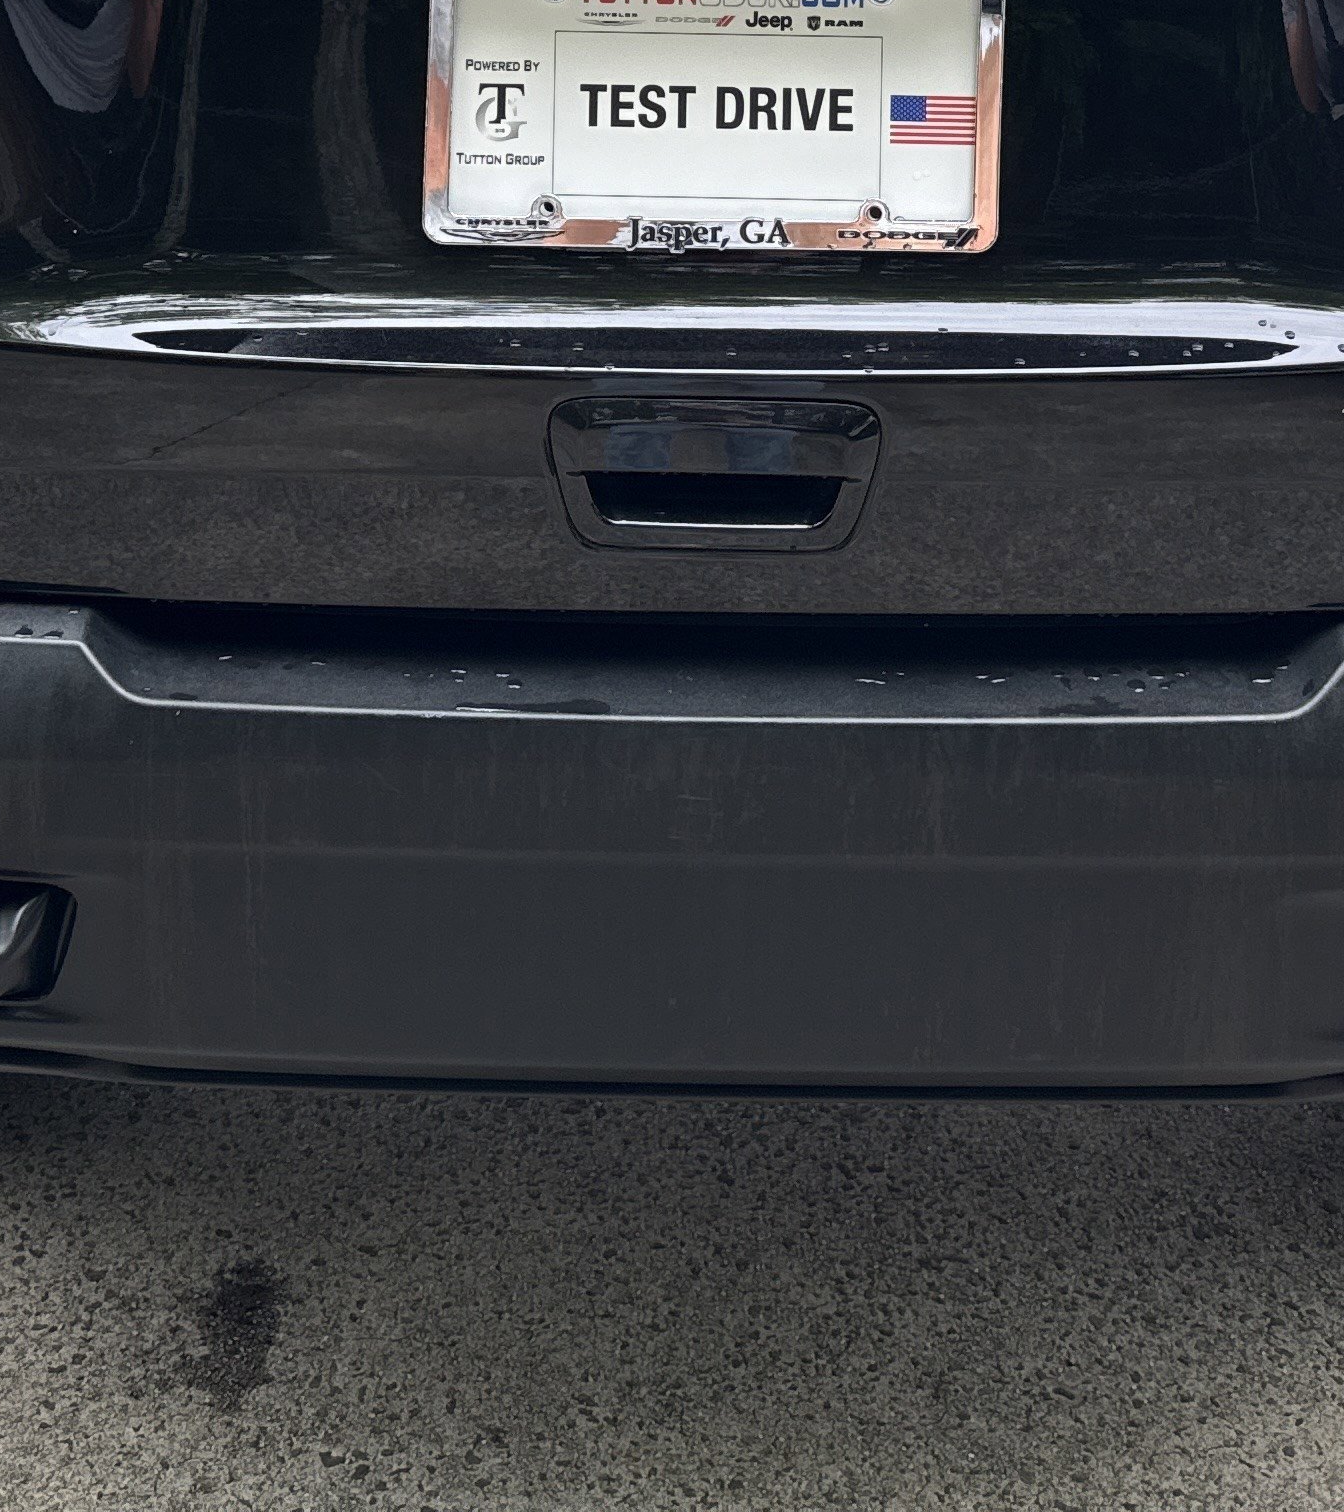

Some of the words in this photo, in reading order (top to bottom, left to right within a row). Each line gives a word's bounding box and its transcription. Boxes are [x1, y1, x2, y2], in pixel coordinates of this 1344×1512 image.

[745, 11, 793, 31] Jeep
[824, 18, 864, 28] RAM
[580, 84, 697, 130] TEST
[716, 88, 854, 132] DRIVE
[455, 219, 550, 227] CHRYSLER
[628, 218, 730, 249] Jasper,
[740, 219, 791, 244] GA
